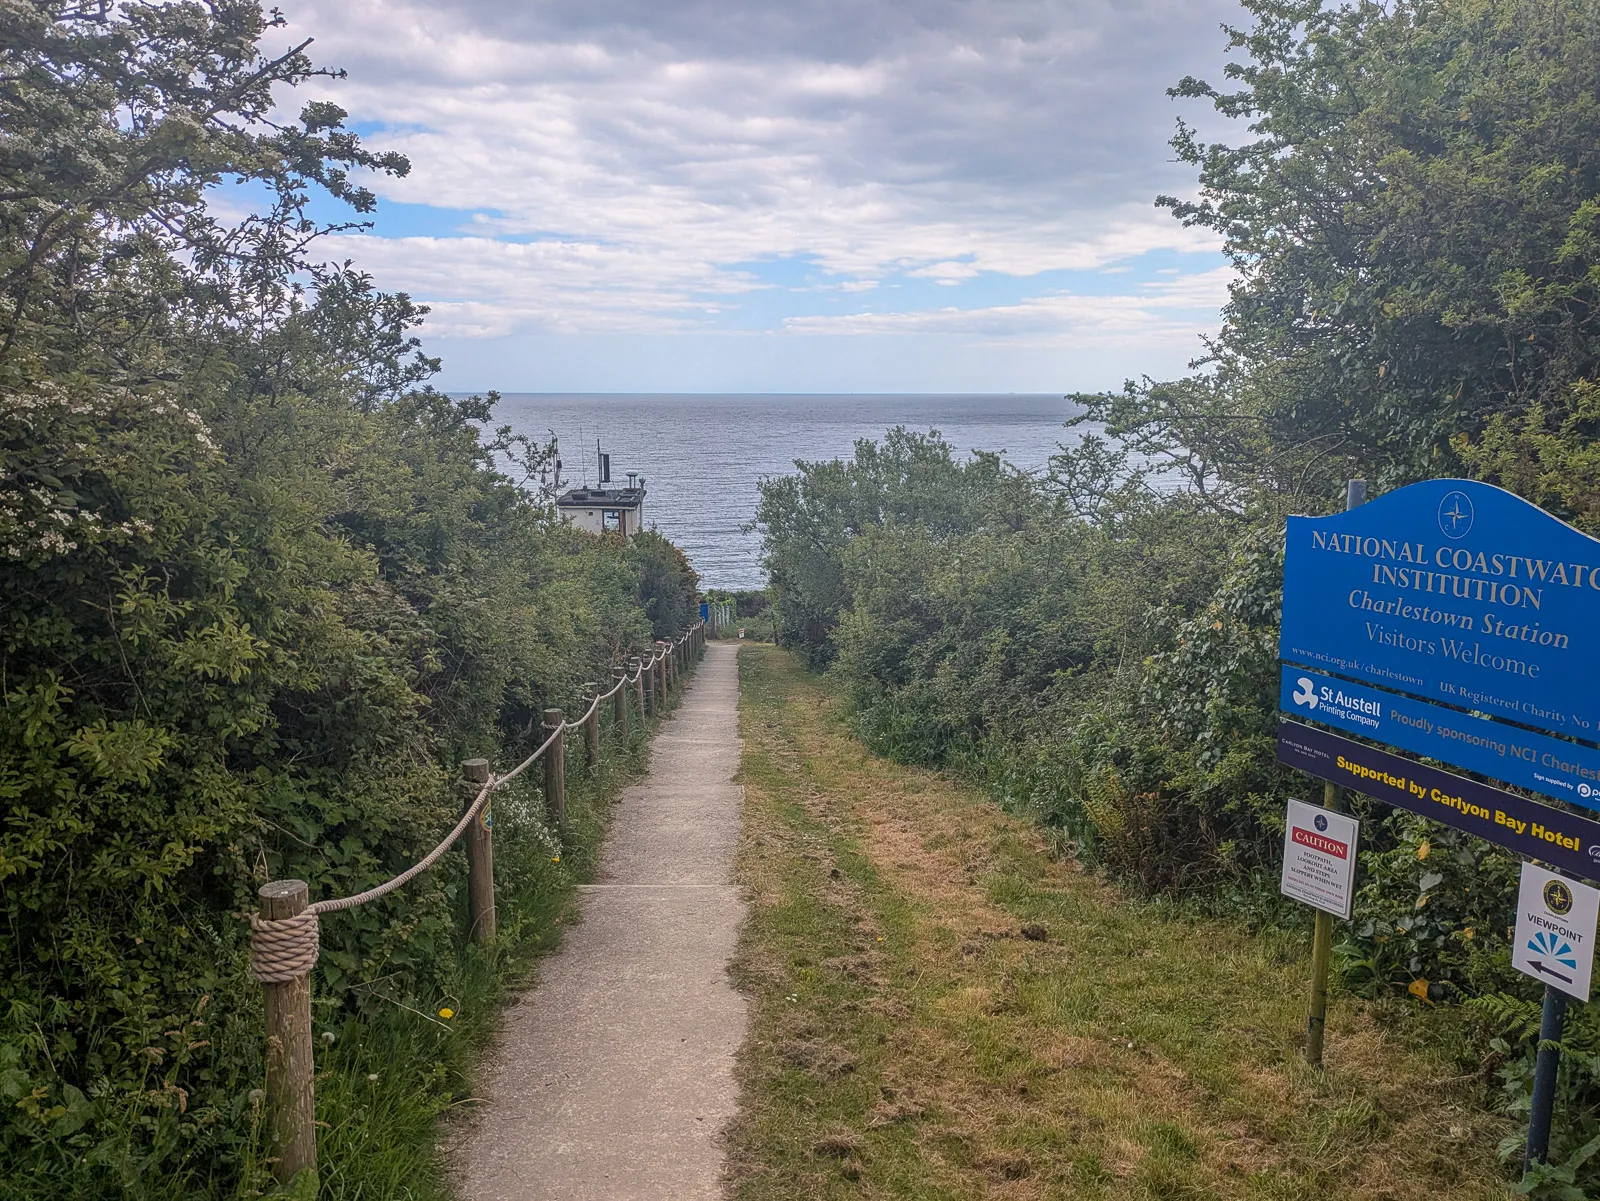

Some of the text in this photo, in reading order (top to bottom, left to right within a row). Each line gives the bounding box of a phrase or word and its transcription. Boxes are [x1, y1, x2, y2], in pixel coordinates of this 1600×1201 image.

[1311, 530, 1429, 565] NATIONAL
[1372, 564, 1543, 611] INSTITUTION
[1349, 589, 1474, 630] Charlestown
[1365, 622, 1436, 656] Visitors
[1481, 613, 1570, 649] Station
[1292, 647, 1424, 686] www.nci.org.uk/charlestown
[1440, 638, 1540, 679] Welcome
[1320, 686, 1380, 717] St Austell
[1320, 702, 1380, 730] Printing Company
[1440, 682, 1456, 694] UK
[1460, 686, 1519, 711] Registered
[1522, 702, 1566, 726] Charity
[1571, 714, 1590, 729] No
[1390, 710, 1434, 734] Proudly
[1436, 725, 1506, 756] sponsoring
[1510, 744, 1537, 763] NCI
[1534, 772, 1574, 790] Sign supplied by
[1336, 756, 1580, 852] Supported by Carlyon Bay Hotel
[1295, 831, 1344, 855] CAUTION
[1290, 866, 1342, 890] SLIPPERY WHEN WET
[1297, 856, 1338, 875] LOOKOUT AREA
[1304, 865, 1331, 878] AND STEPS
[1527, 912, 1583, 944] VIEWPOINT
